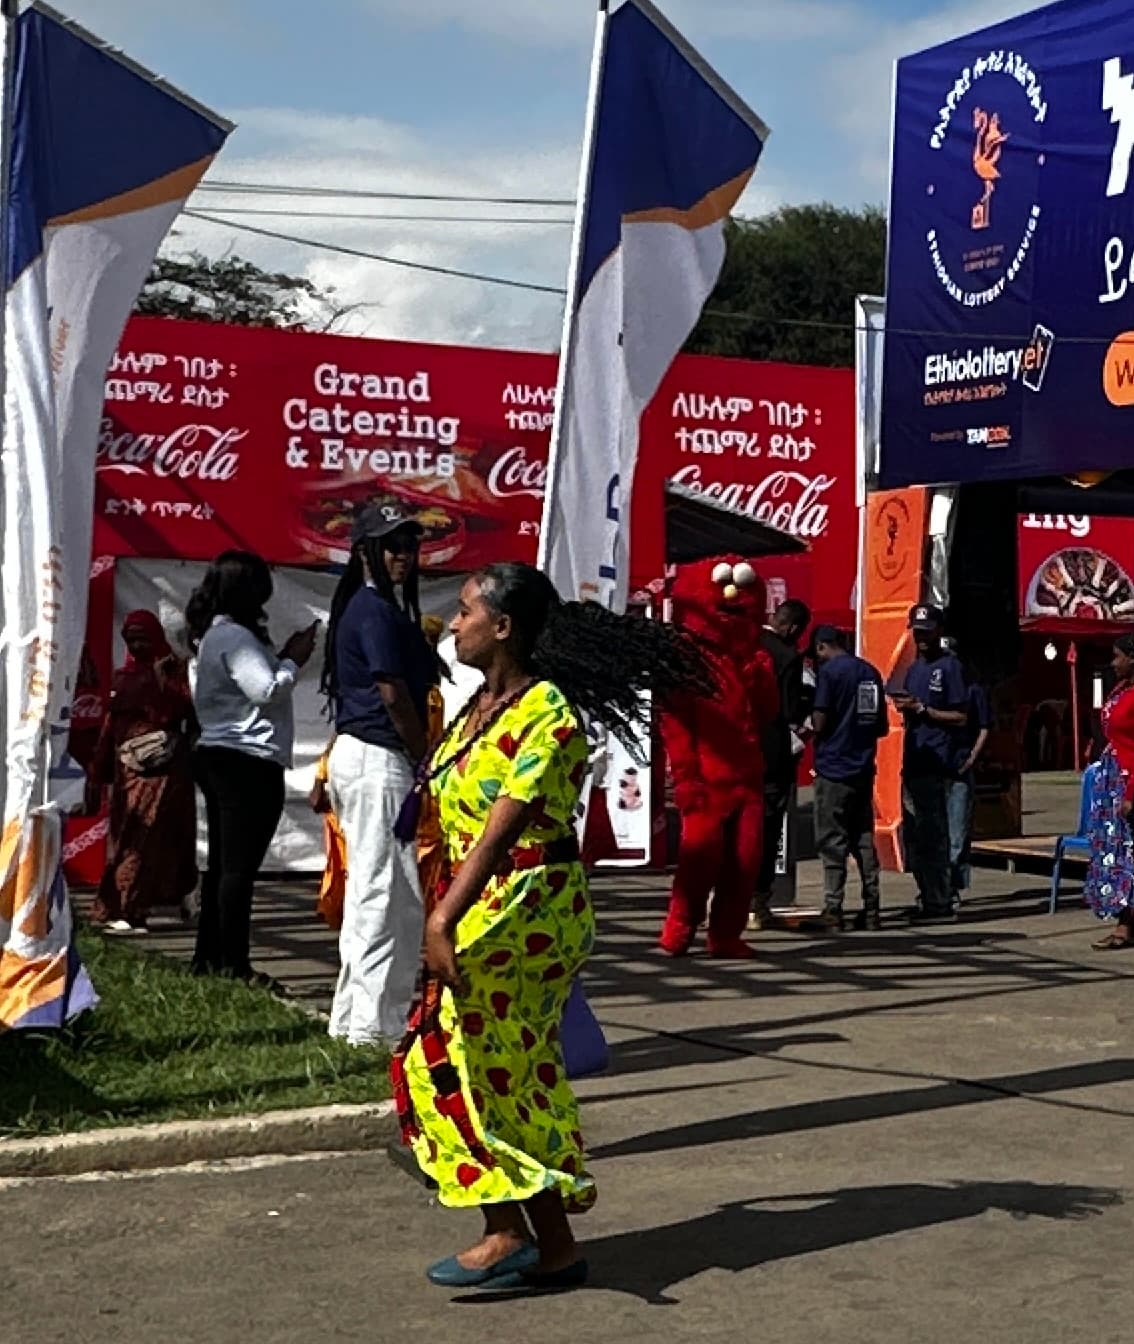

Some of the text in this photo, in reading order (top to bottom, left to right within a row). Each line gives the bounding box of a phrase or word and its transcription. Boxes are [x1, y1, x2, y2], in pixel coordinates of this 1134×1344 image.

[313, 362, 432, 403] Grand
[282, 398, 460, 446] Catering
[96, 417, 250, 481] oca-Cola
[285, 436, 456, 478] & Events
[488, 446, 549, 497] Coc
